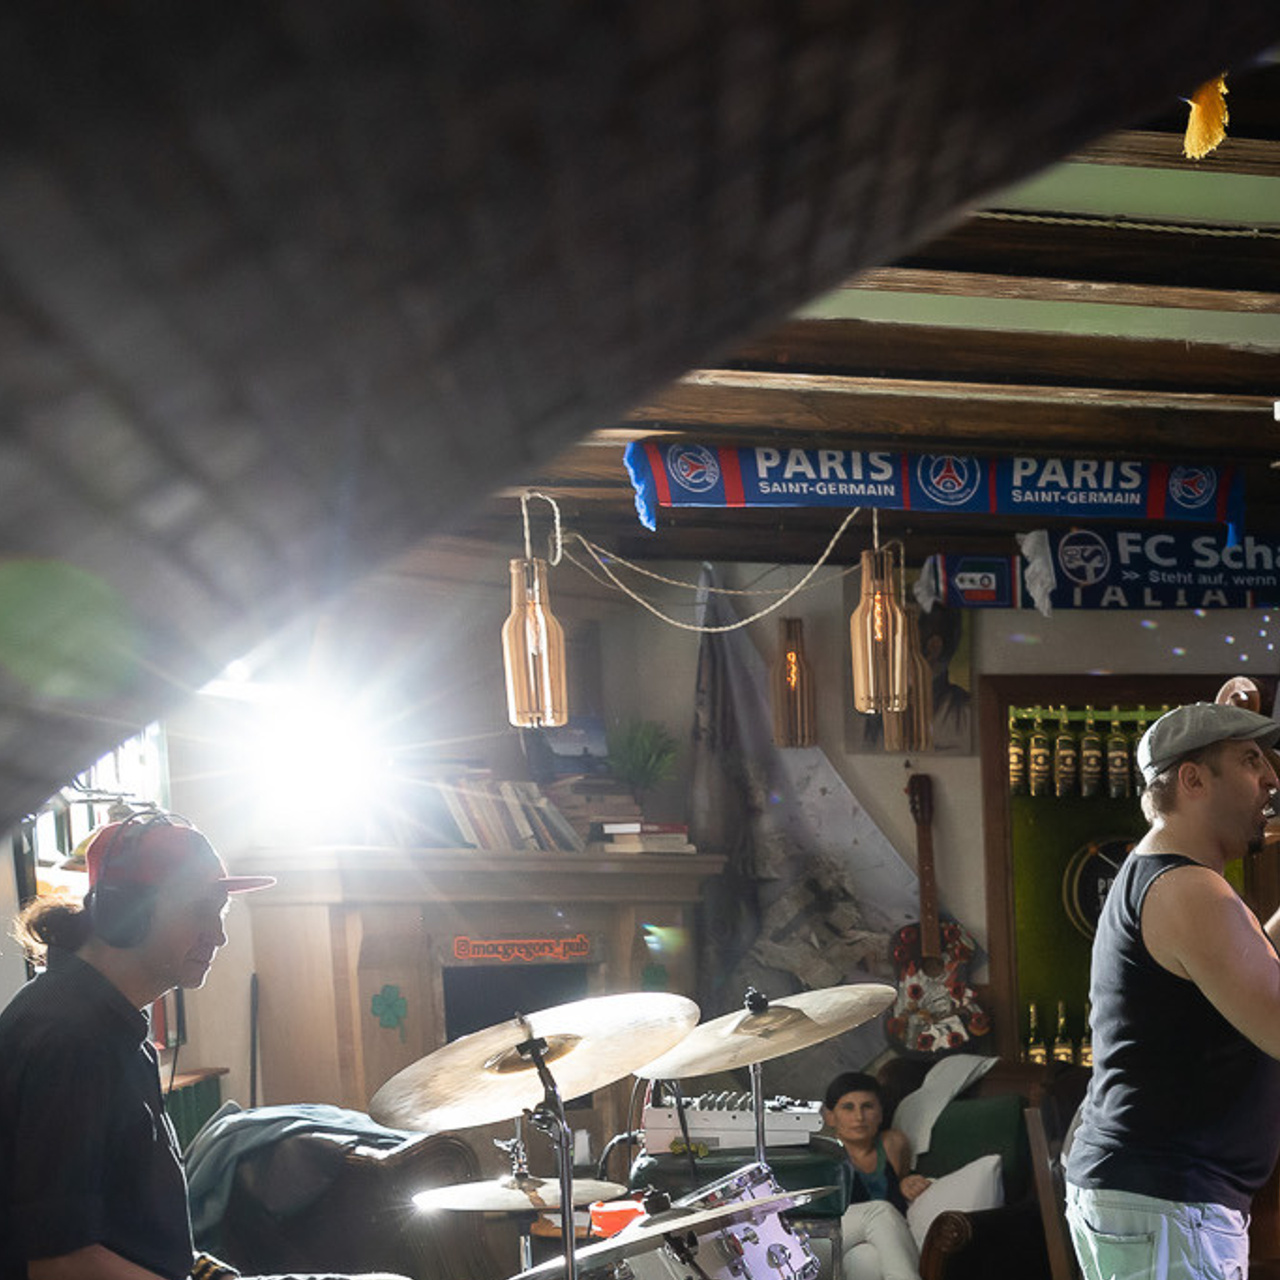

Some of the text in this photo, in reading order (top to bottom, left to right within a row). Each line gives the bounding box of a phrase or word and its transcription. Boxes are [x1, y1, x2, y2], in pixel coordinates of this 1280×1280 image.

[755, 447, 894, 481] PARIS
[1012, 457, 1143, 490] PARIS
[758, 481, 896, 496] SAINT-GERMAIN
[1011, 489, 1142, 505] SAINT-GERMAIN
[1116, 532, 1177, 567] FC
[1148, 569, 1193, 585] Steht
[1231, 574, 1278, 587] wenn
